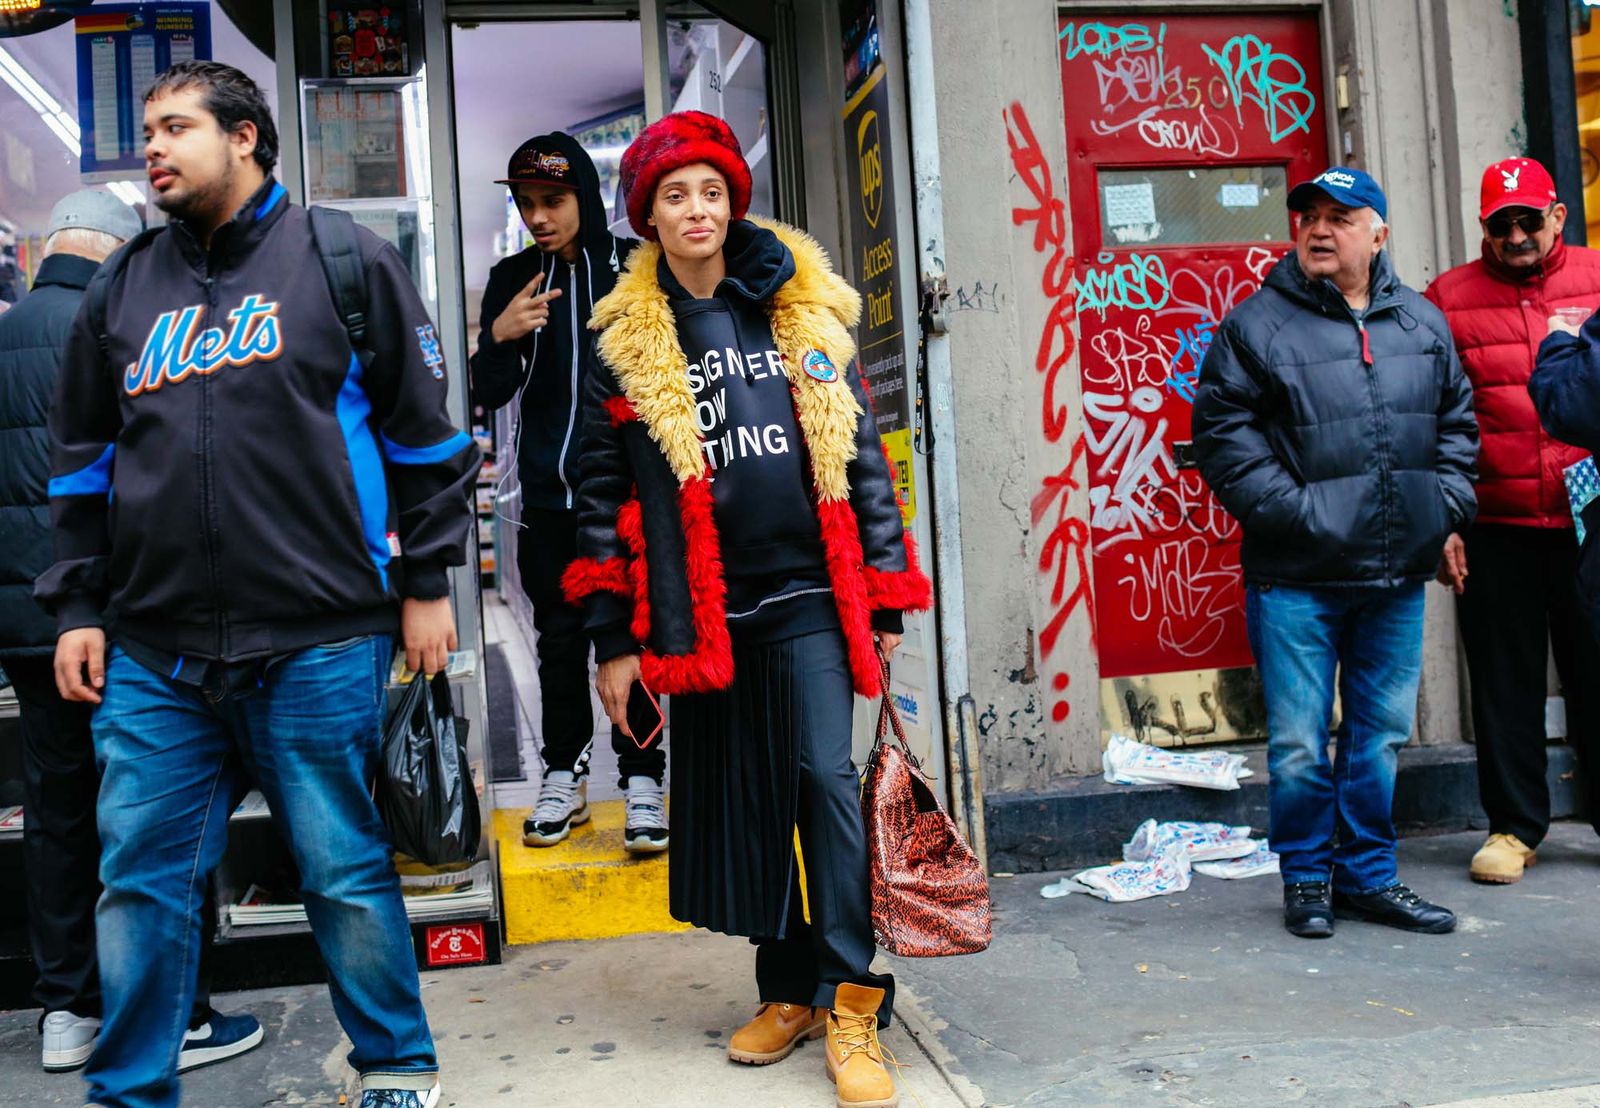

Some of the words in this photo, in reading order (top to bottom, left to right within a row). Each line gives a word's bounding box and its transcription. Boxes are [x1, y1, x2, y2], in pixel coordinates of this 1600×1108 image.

[709, 70, 721, 93] 252
[1163, 75, 1228, 111] 250
[861, 143, 880, 210] ups
[863, 237, 893, 282] Access
[867, 286, 893, 331] Point
[124, 293, 283, 396] Mets
